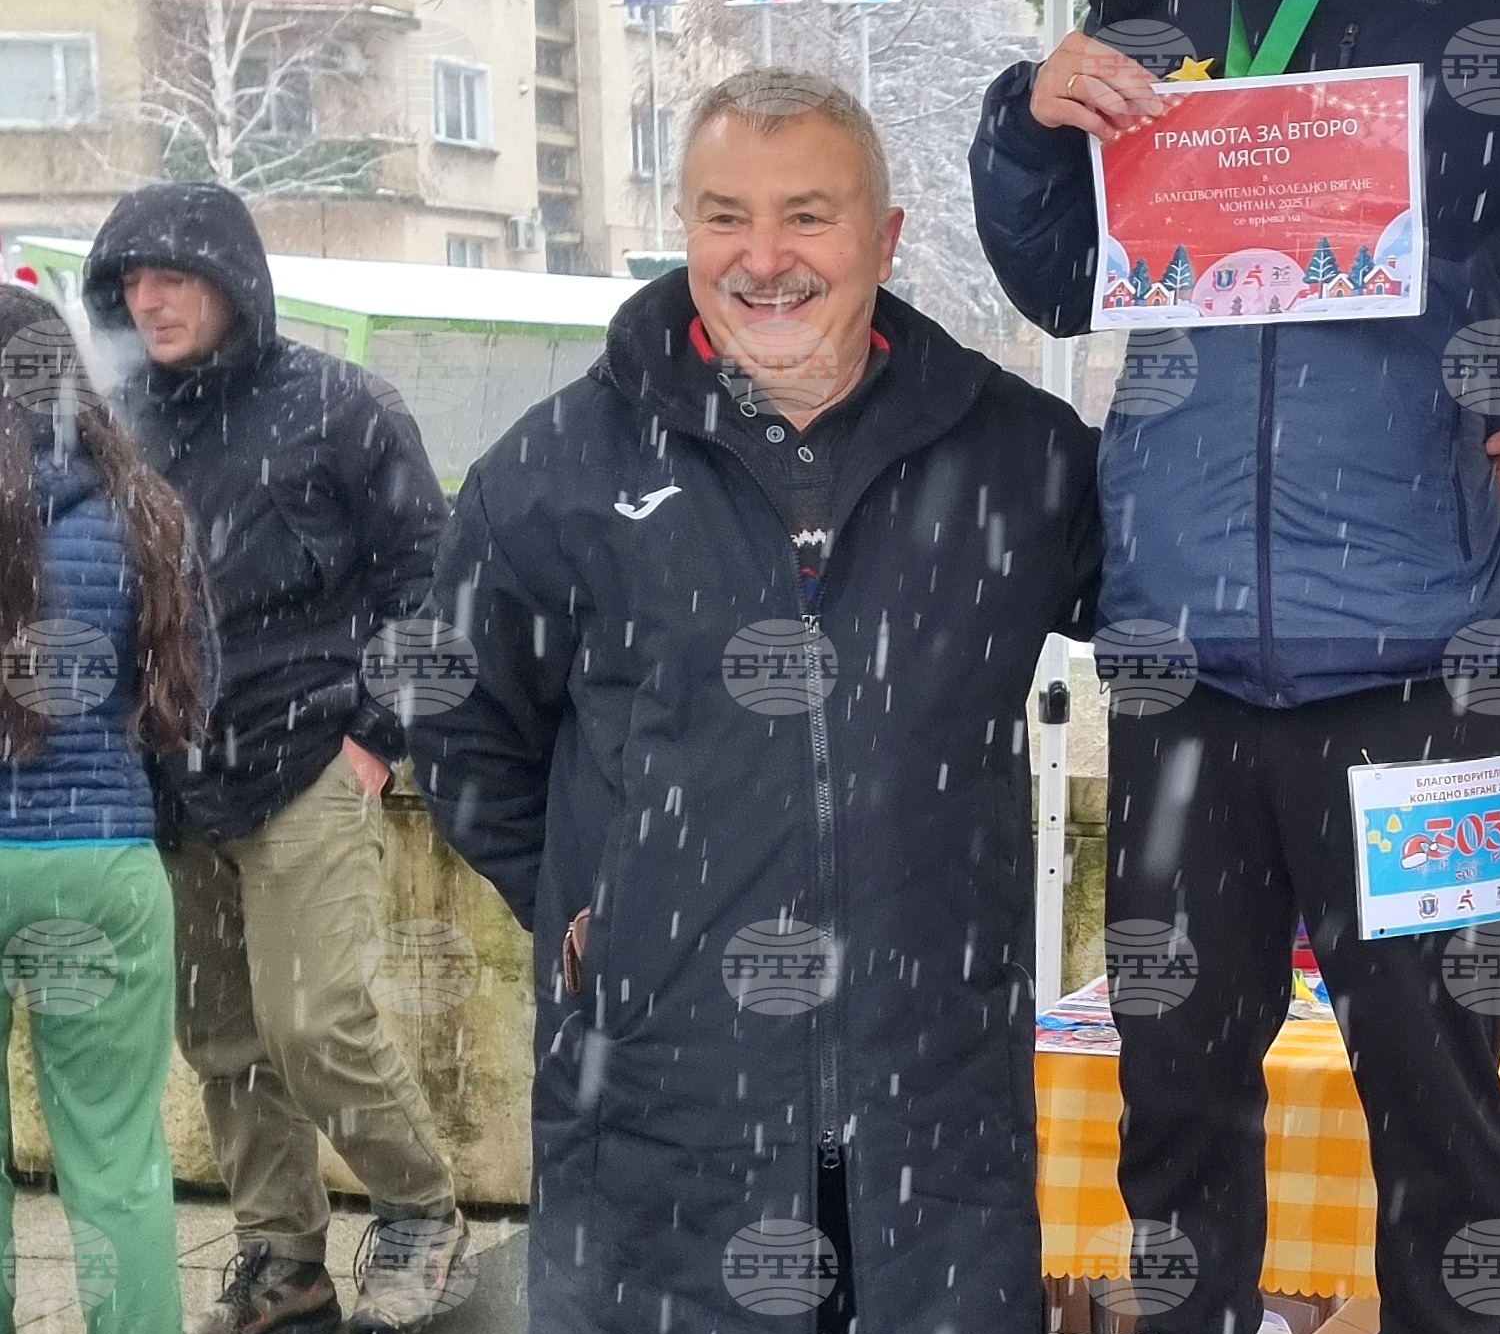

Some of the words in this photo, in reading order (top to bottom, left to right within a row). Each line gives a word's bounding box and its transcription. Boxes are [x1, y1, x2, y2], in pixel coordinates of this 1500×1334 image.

[1154, 126, 1252, 149] ГРАМОТА
[1256, 124, 1282, 142] ЗА
[1288, 118, 1358, 140] ВТОРО
[1218, 147, 1290, 168] МЯСТО
[1155, 184, 1265, 203] БЛАГОТВОРИТЕЛНО
[1269, 181, 1328, 196] КОЛЕДНО
[1330, 178, 1372, 191] БЯГАНЕ
[1220, 199, 1276, 212] МОНТАНА
[1279, 197, 1302, 210] 2025
[1233, 217, 1247, 226] се
[1250, 215, 1284, 227] връчва
[1288, 214, 1301, 223] на
[1410, 790, 1461, 803] КОЛЕДНО
[1464, 785, 1497, 798] БЯГАНЕ
